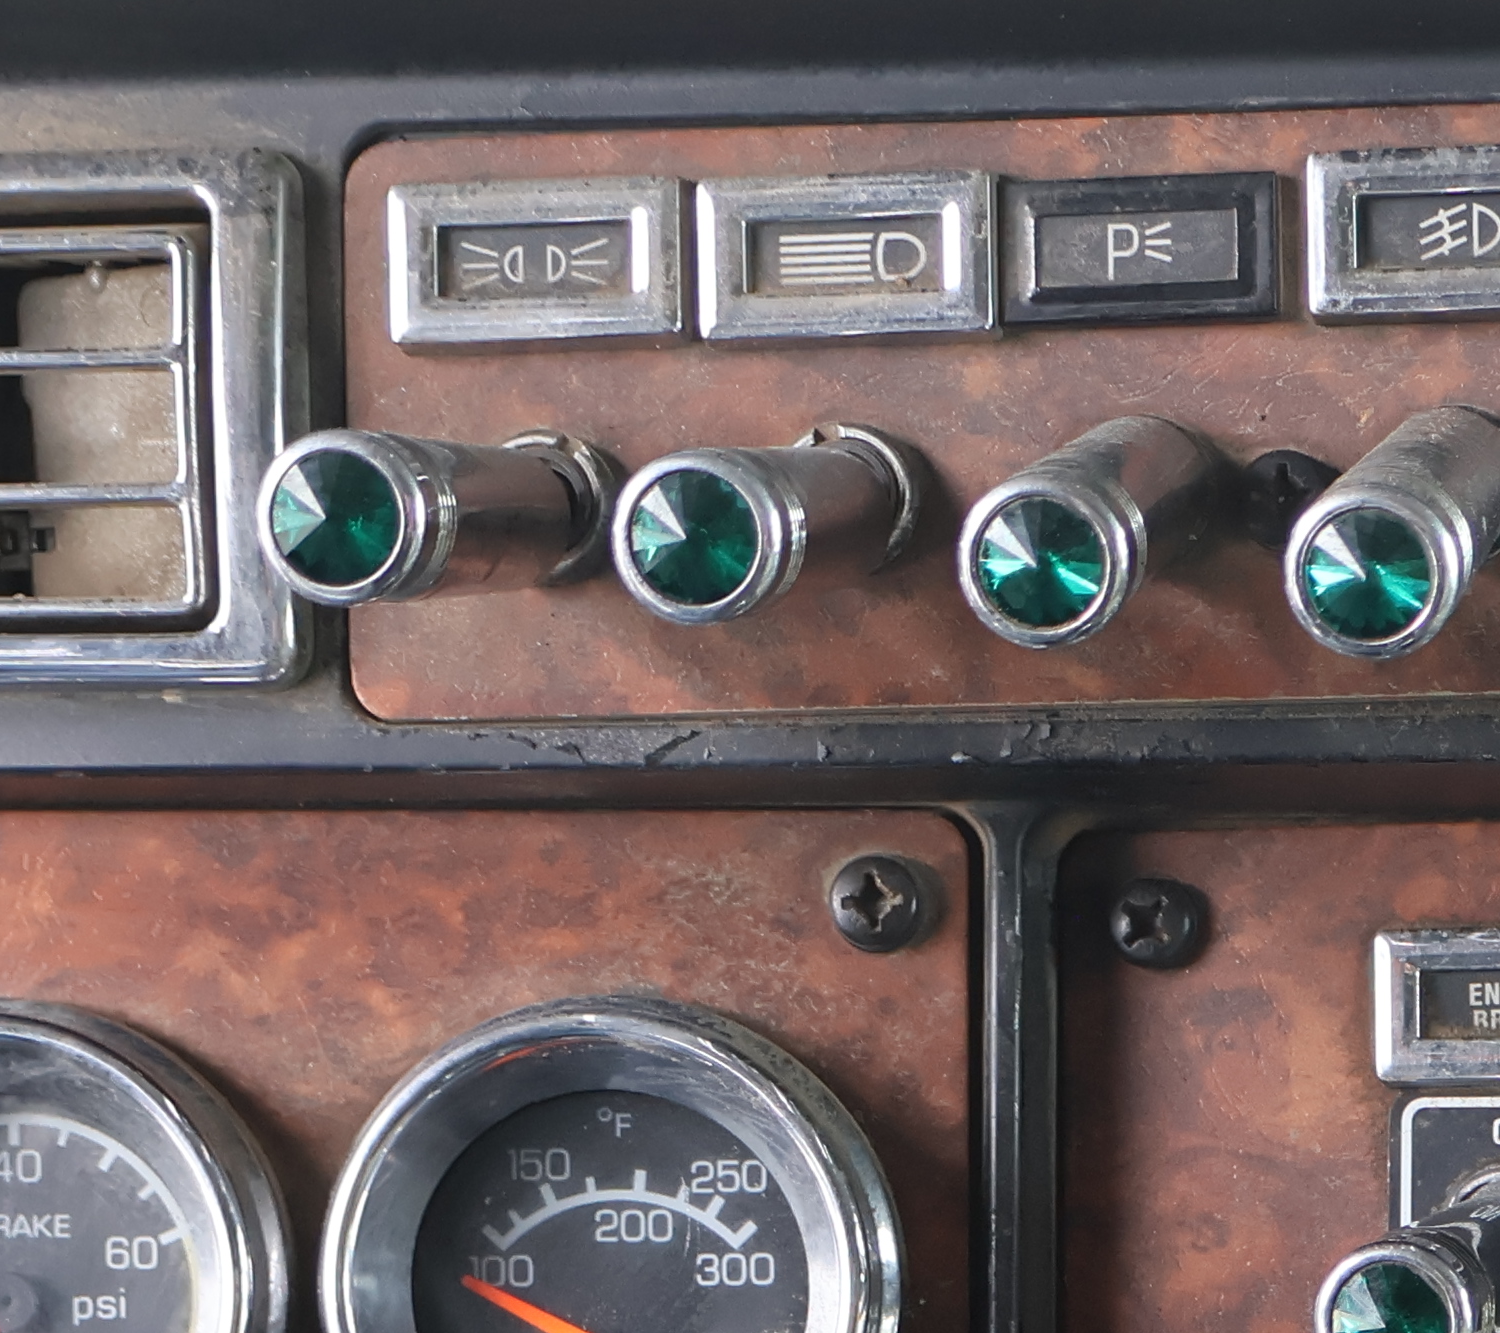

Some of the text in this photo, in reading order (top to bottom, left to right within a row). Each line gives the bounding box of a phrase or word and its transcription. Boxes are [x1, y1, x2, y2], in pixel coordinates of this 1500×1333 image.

[506, 1148, 571, 1181] 150
[689, 1160, 768, 1195] 250
[593, 1208, 674, 1244] 200
[104, 1236, 159, 1271] 60
[695, 1252, 776, 1287] 300
[71, 1287, 128, 1325] psi
